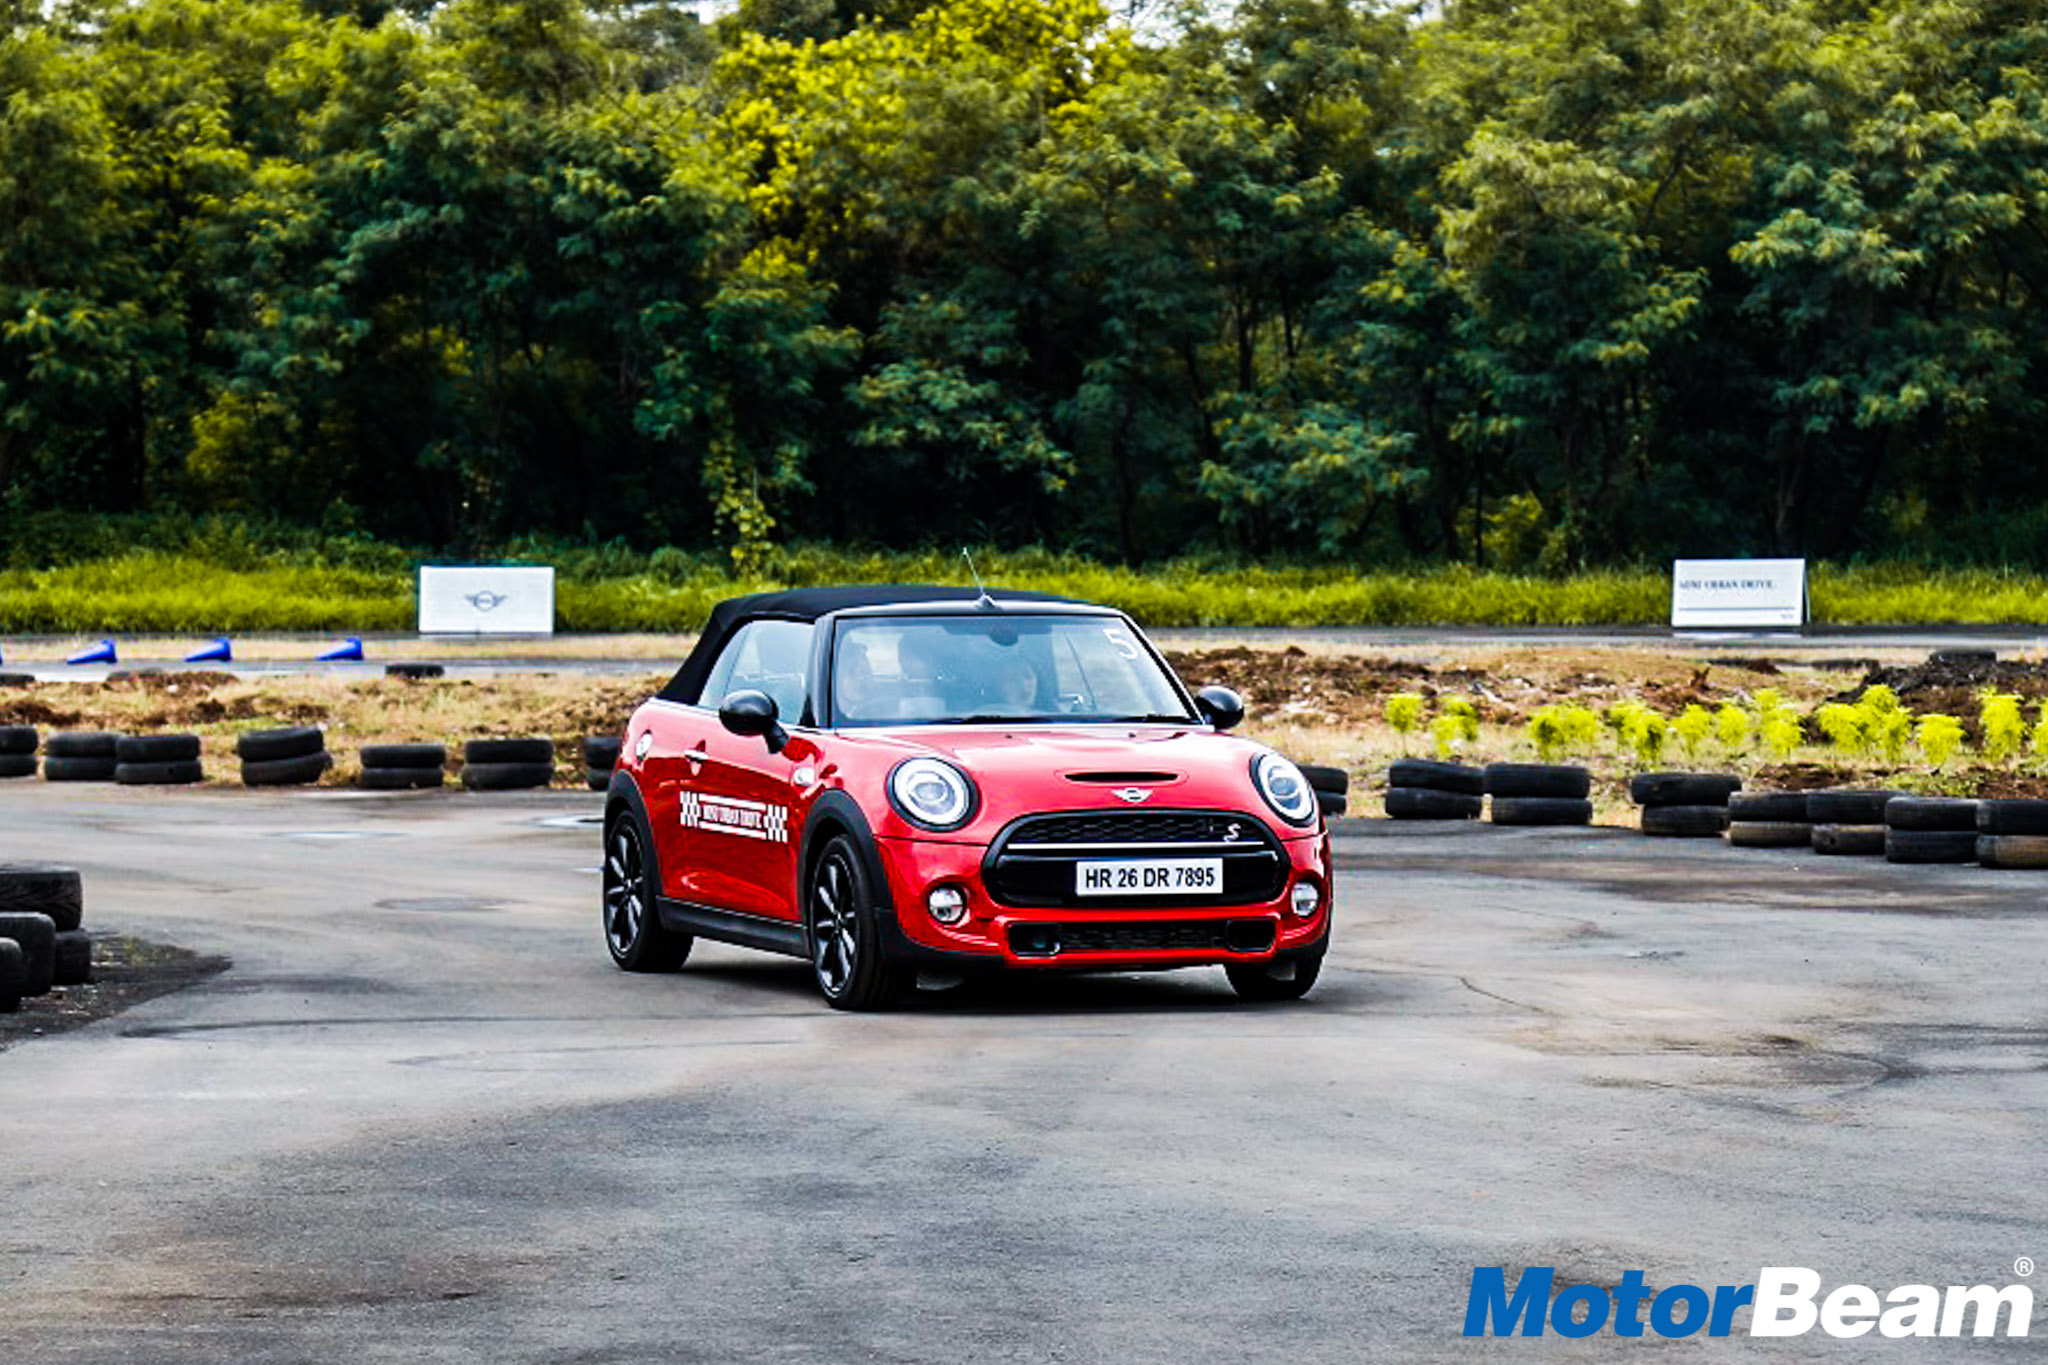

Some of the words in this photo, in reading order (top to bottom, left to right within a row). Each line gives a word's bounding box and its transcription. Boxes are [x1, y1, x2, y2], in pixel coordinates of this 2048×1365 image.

[1103, 628, 1138, 660] 5
[1223, 823, 1241, 843] S
[1085, 868, 1112, 888] HR
[1118, 868, 1138, 888] 26
[1143, 867, 1169, 888] DR
[1175, 867, 1215, 887] 7895
